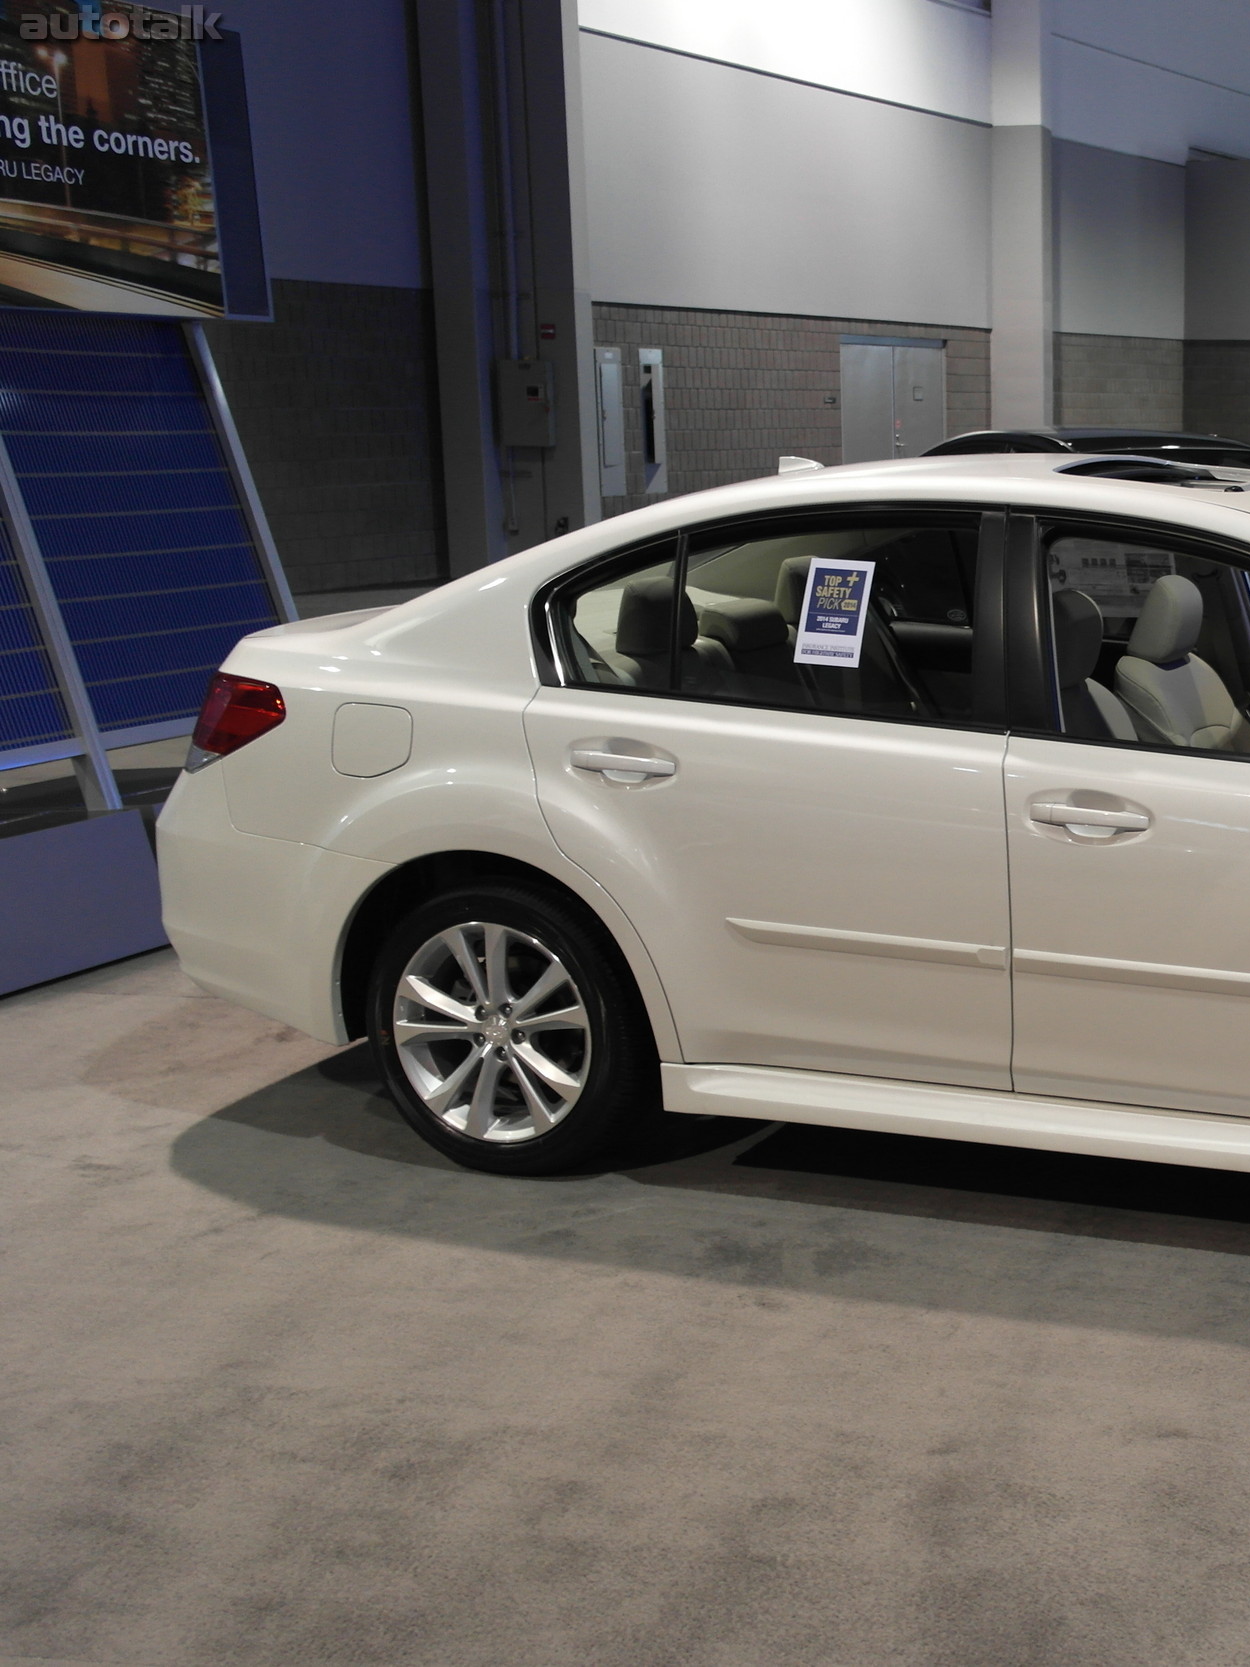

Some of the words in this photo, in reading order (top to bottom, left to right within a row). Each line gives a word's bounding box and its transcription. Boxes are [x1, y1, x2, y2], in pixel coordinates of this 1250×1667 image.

[0, 60, 58, 98] ffice
[38, 114, 85, 148] the
[93, 128, 200, 164] corners.
[22, 161, 85, 186] LEGACY
[824, 575, 843, 587] TOP
[815, 586, 852, 598] SAFETY
[816, 597, 842, 610] PICK
